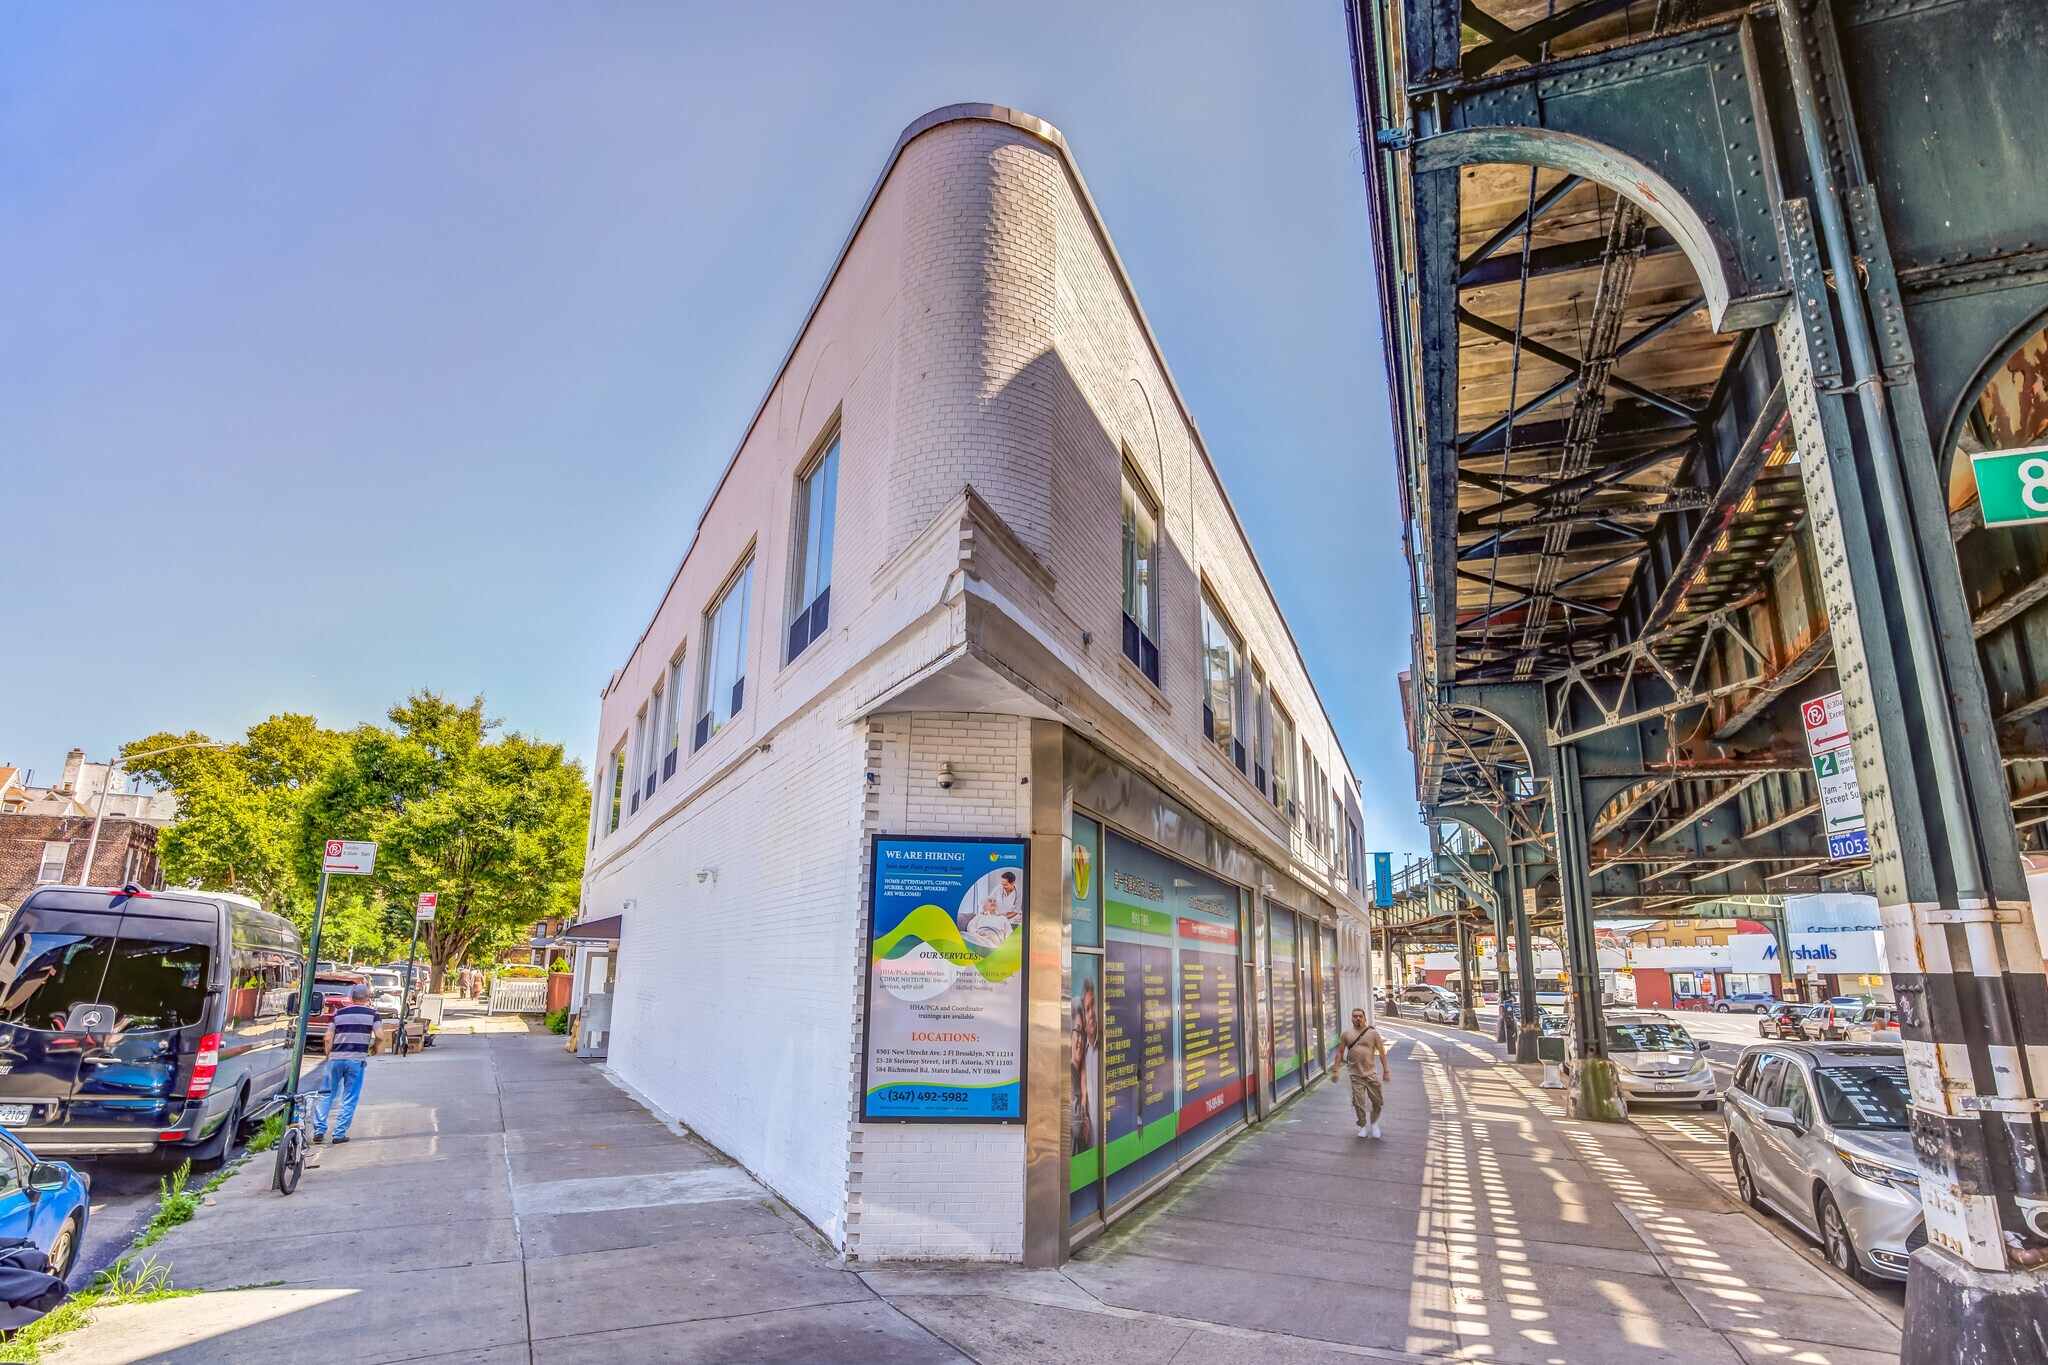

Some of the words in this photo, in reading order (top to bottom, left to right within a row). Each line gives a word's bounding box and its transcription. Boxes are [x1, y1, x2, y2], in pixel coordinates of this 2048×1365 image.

[1826, 699, 1843, 710] 6:30a
[1828, 710, 1845, 720] Excep
[1837, 749, 1850, 758] hour
[1820, 754, 1833, 776] 2
[1839, 757, 1854, 766] mete
[1841, 765, 1855, 775] park
[1823, 786, 1838, 796] 7am
[1843, 780, 1858, 791] 7pm
[1825, 794, 1849, 805] Except
[1850, 791, 1860, 799] Su
[1832, 837, 1870, 857] 31053
[886, 850, 902, 859] WE
[903, 851, 923, 860] ARE
[924, 851, 966, 861] HIRING!
[910, 864, 949, 872] Fast-growing
[919, 951, 938, 960] OUR
[939, 952, 981, 961] SERVICES:
[1762, 944, 1838, 960] Mrshalls
[911, 1032, 980, 1042] LOCATIONS:
[887, 1090, 915, 1103] (347)
[917, 1091, 969, 1102] 492-5982
